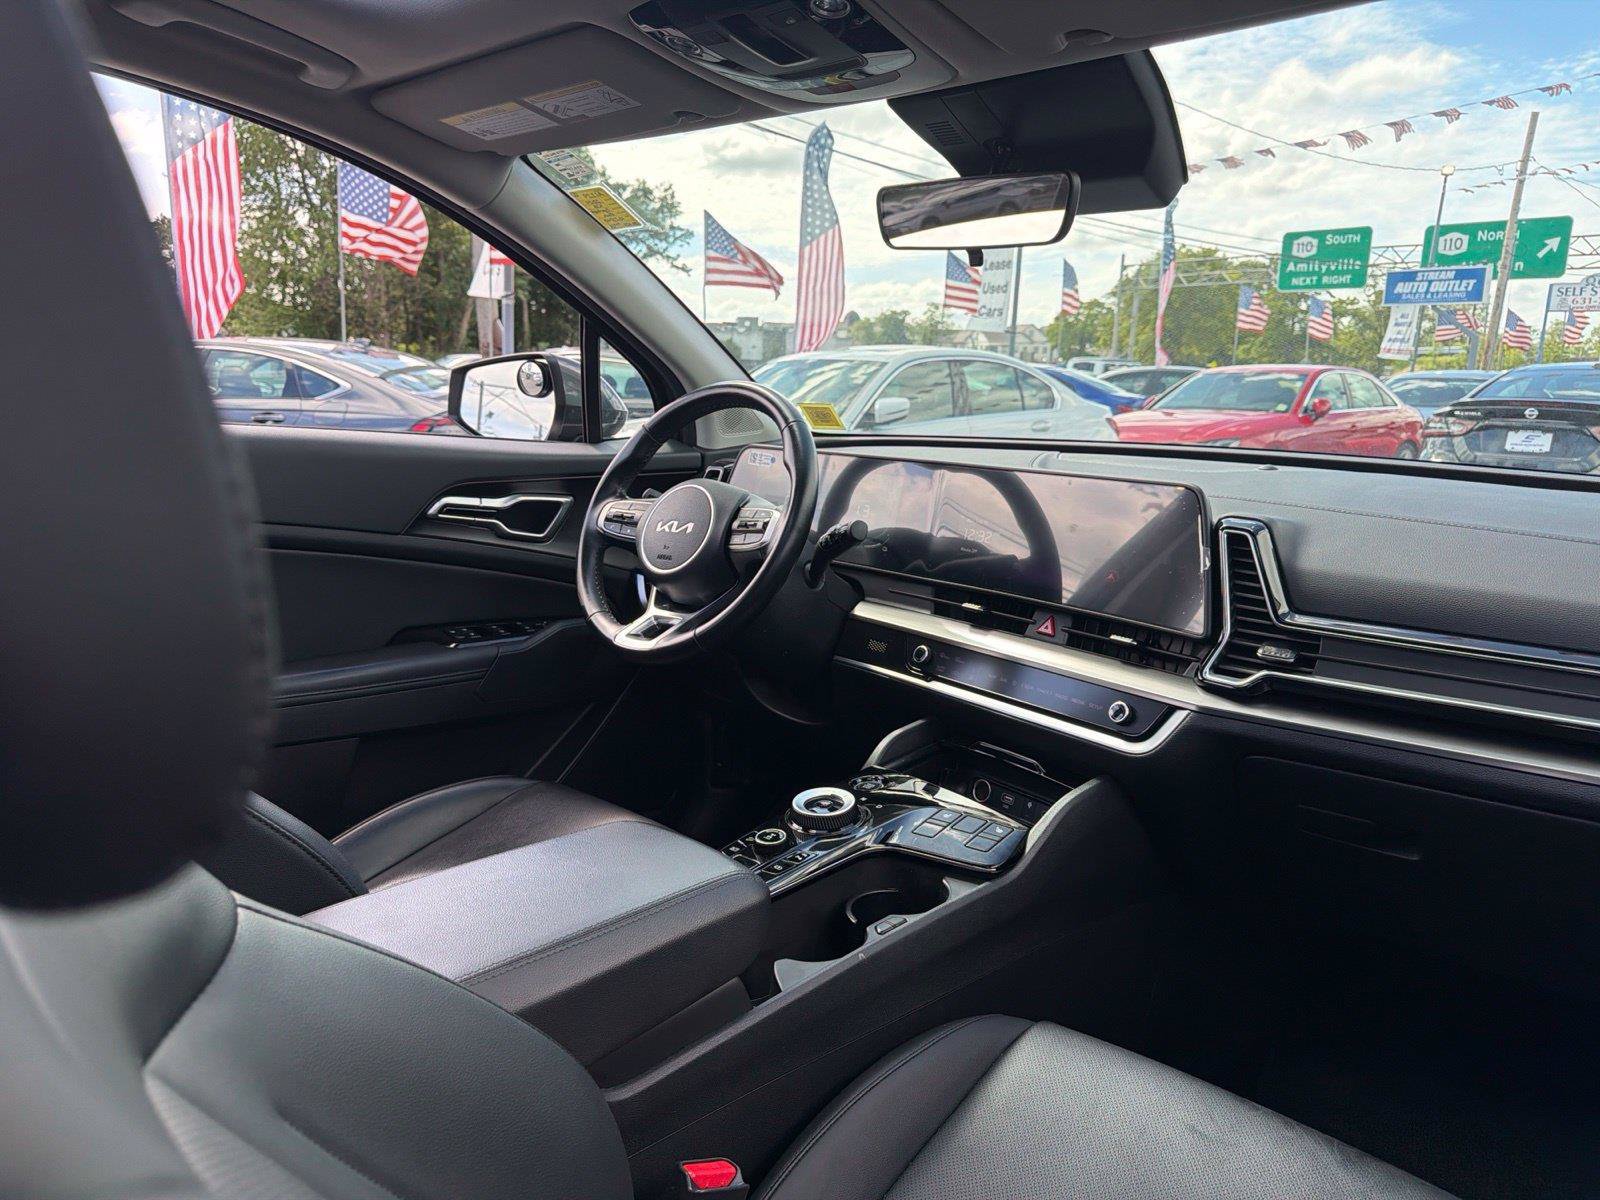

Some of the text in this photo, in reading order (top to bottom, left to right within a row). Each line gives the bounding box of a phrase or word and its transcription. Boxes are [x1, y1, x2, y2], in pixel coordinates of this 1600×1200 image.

[1296, 233, 1361, 253] 110 SOUTH
[1443, 229, 1520, 251] 110 NORH
[1285, 258, 1362, 273] Amityville
[1291, 274, 1352, 286] NEXT RIGHT
[1416, 271, 1456, 280] STREAM
[1394, 279, 1477, 294] AUTO OUTLET
[1557, 286, 1586, 297] SELF
